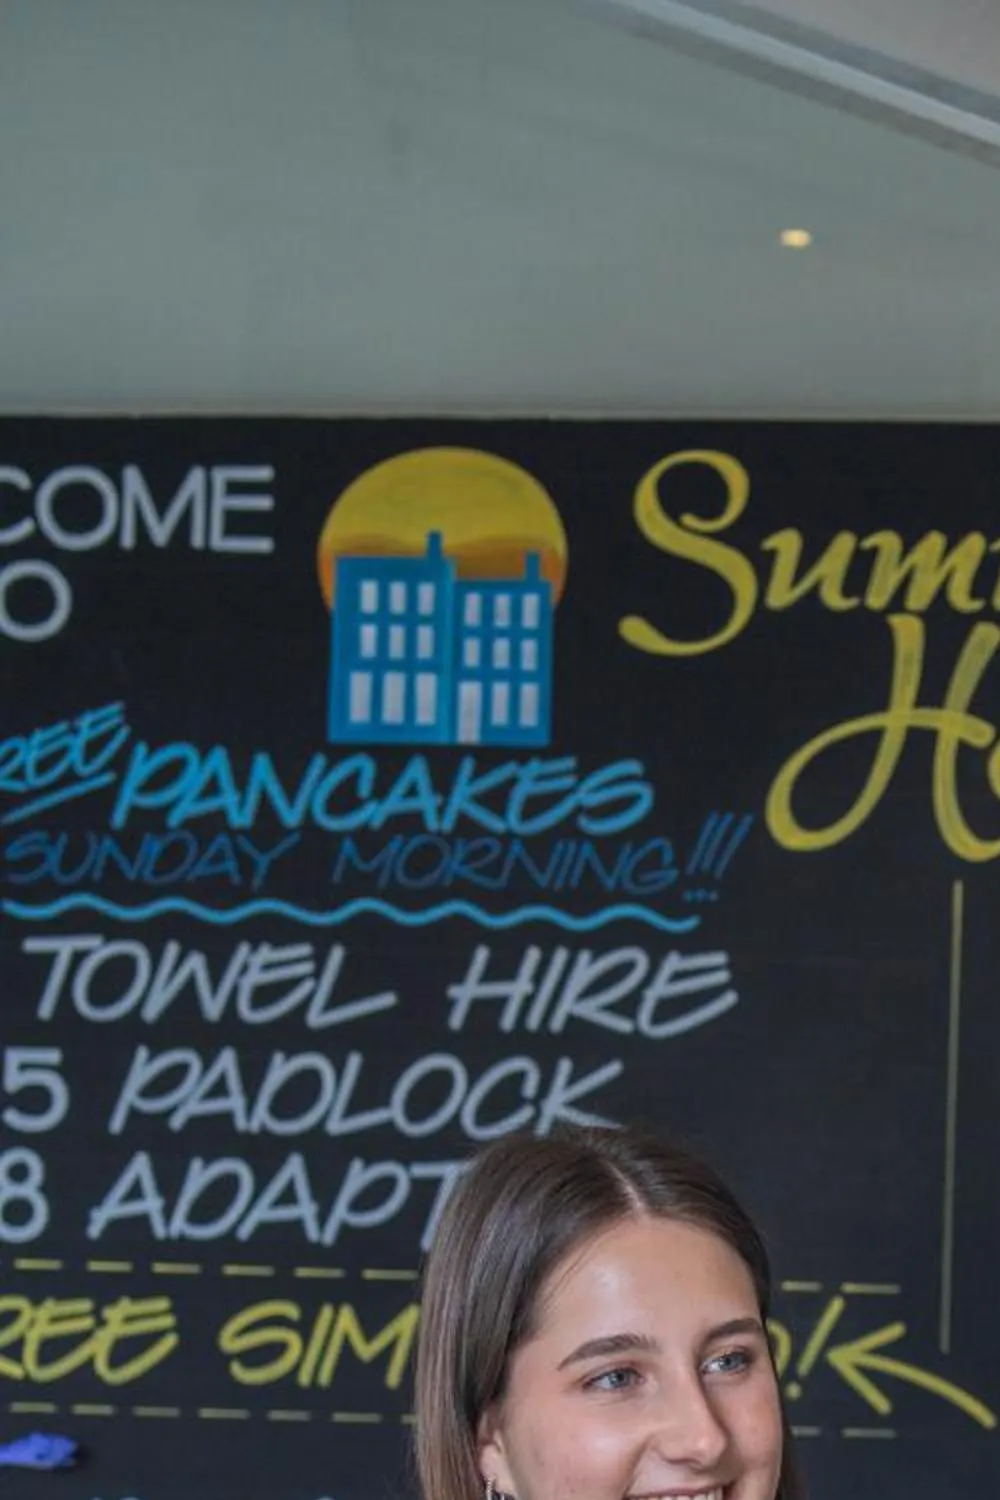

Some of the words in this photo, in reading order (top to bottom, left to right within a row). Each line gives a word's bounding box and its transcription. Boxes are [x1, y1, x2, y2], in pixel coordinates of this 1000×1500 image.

[110, 740, 654, 836] PANCAKES
[4, 828, 303, 890] SUNDAY
[22, 935, 398, 1030] TOWEL
[447, 944, 739, 1039] HIRE
[108, 1044, 624, 1141] PADLOCK
[218, 1299, 422, 1390] SIM
